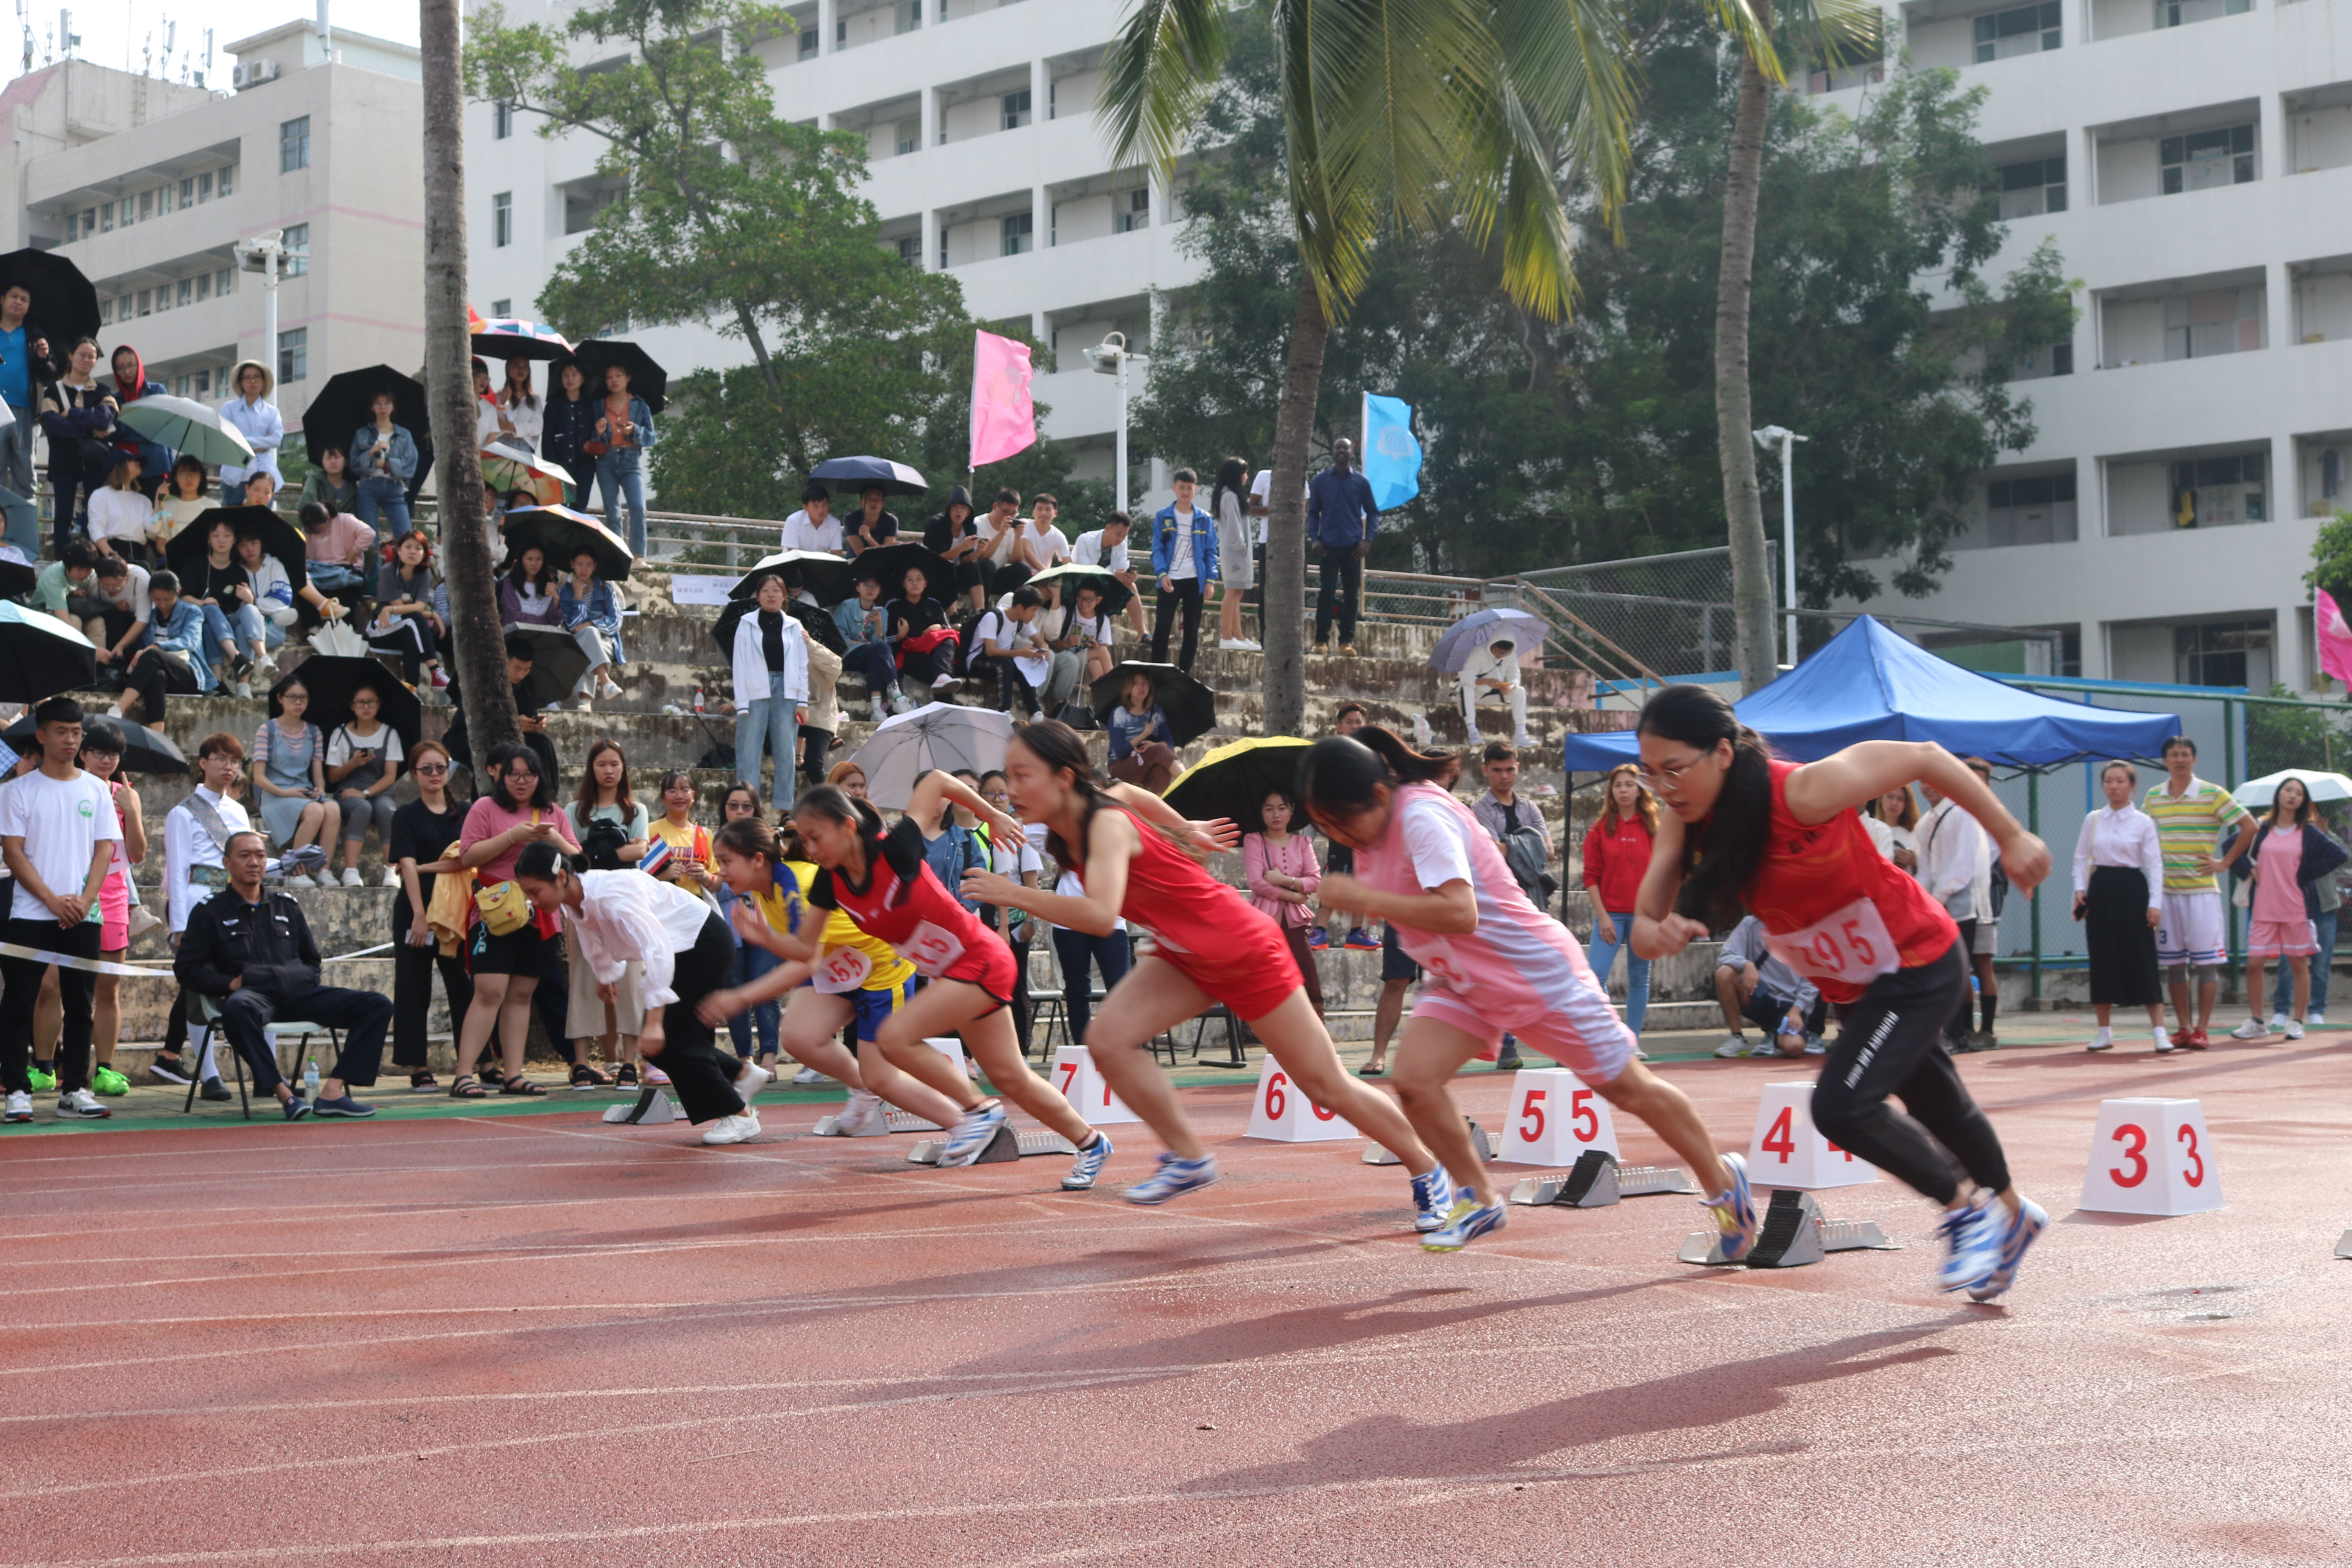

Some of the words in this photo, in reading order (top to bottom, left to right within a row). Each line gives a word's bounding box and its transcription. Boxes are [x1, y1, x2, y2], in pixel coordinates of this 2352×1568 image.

[2159, 930, 2167, 944] 3
[1060, 1063, 1077, 1096] 7
[1265, 1072, 1287, 1120] 6
[1519, 1090, 1546, 1142] 5
[1572, 1089, 1599, 1142] 5
[1762, 1107, 1795, 1163] 4
[2109, 1123, 2148, 1188] 3
[2178, 1123, 2203, 1187] 3
